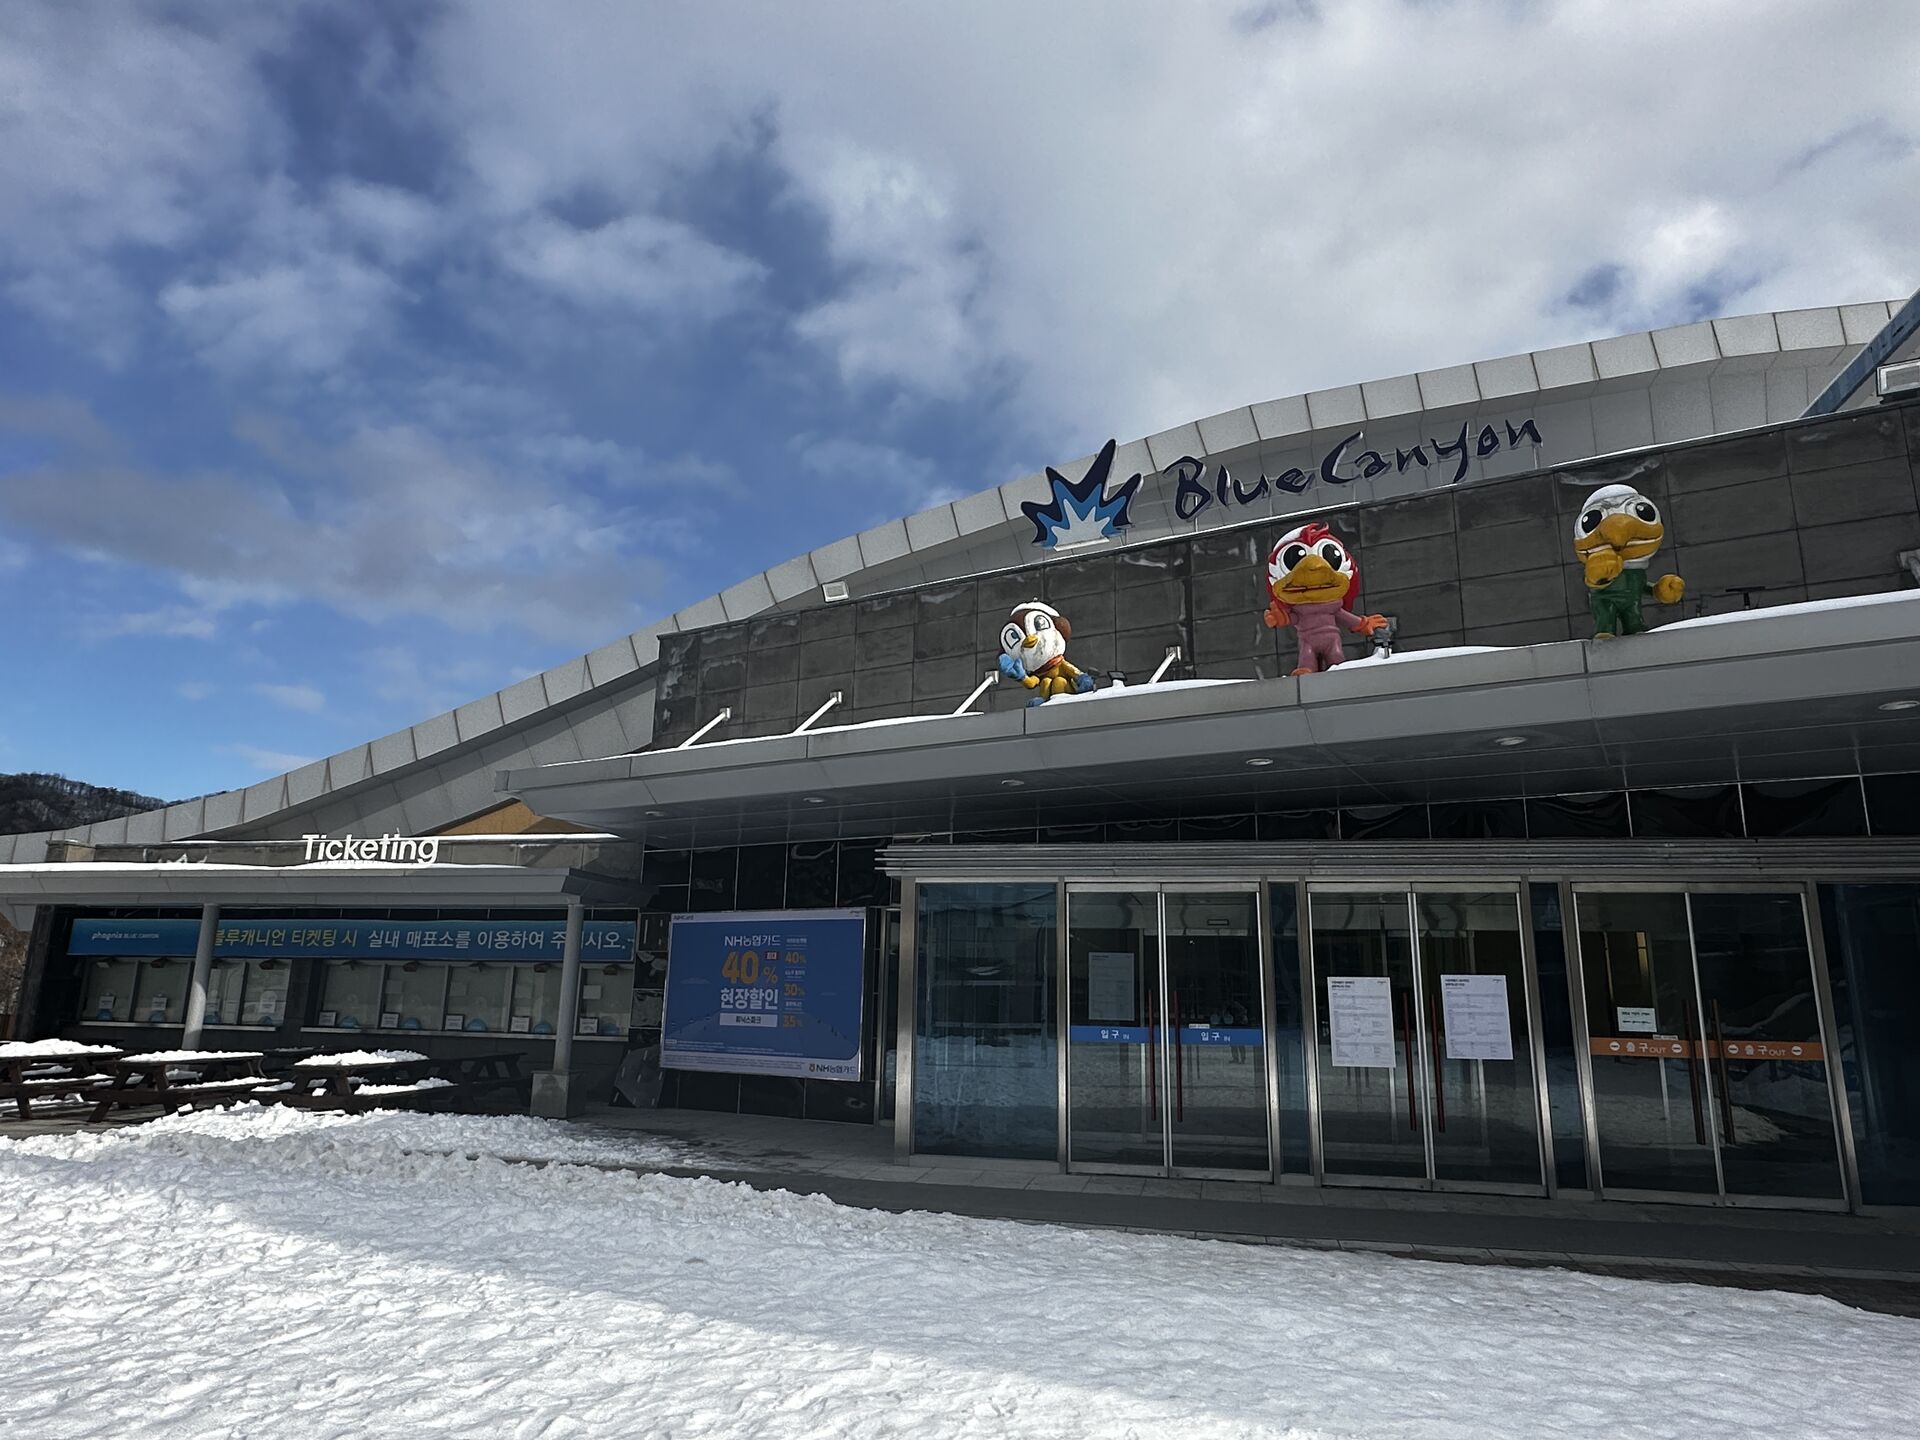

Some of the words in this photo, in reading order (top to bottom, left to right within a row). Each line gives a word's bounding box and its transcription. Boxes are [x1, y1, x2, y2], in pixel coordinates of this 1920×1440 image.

[301, 832, 439, 865] Ticketing
[291, 928, 337, 948] 티켓팅
[341, 929, 358, 947] 시
[368, 930, 400, 948] 실내
[406, 930, 471, 949] 매표소를
[477, 930, 545, 949] 이용하여
[724, 935, 781, 947] NH농협카드
[721, 988, 778, 1010] 현장할인
[1769, 1049, 1787, 1057] OUT
